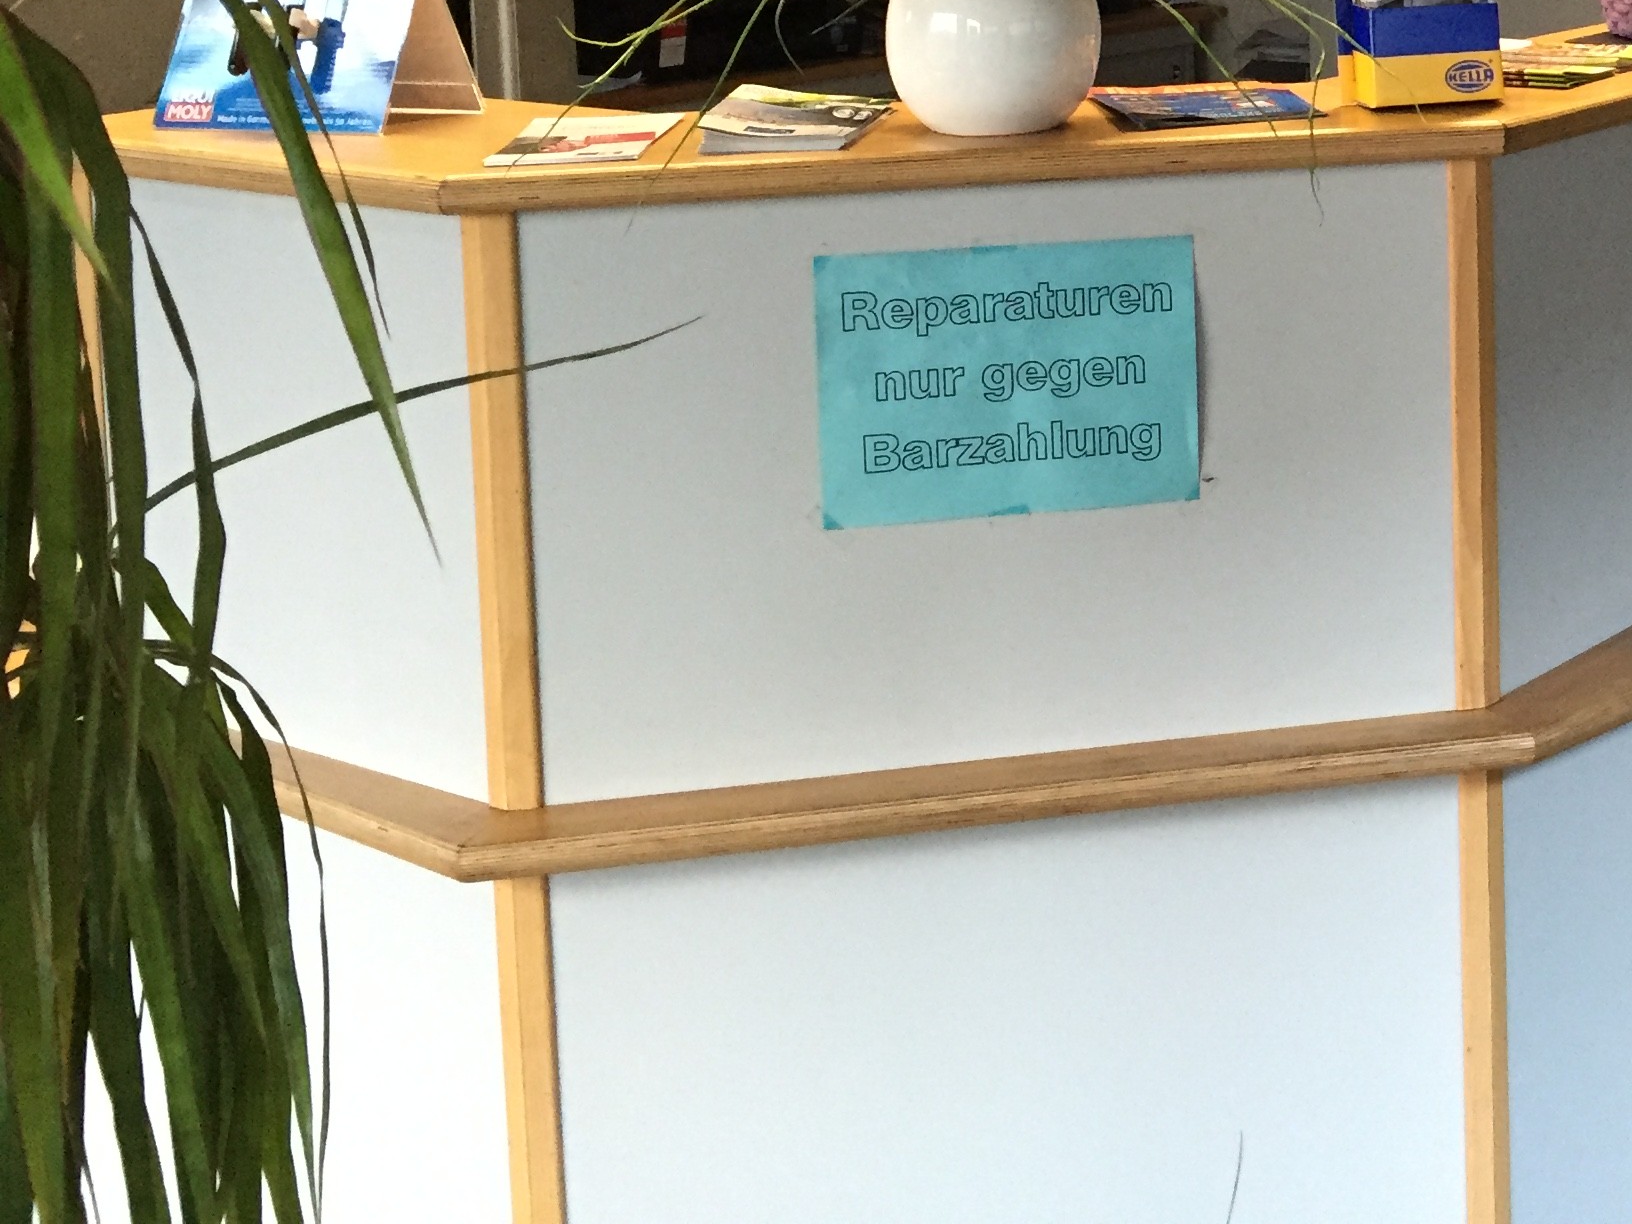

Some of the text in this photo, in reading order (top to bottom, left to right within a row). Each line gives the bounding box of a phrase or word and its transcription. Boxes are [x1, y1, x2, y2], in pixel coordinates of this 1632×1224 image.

[1448, 65, 1495, 84] HELLA
[167, 103, 212, 120] MOLY
[841, 281, 1173, 337] Reparaturen
[875, 354, 1146, 402] nur gegen
[863, 420, 1163, 474] Barzahlung
